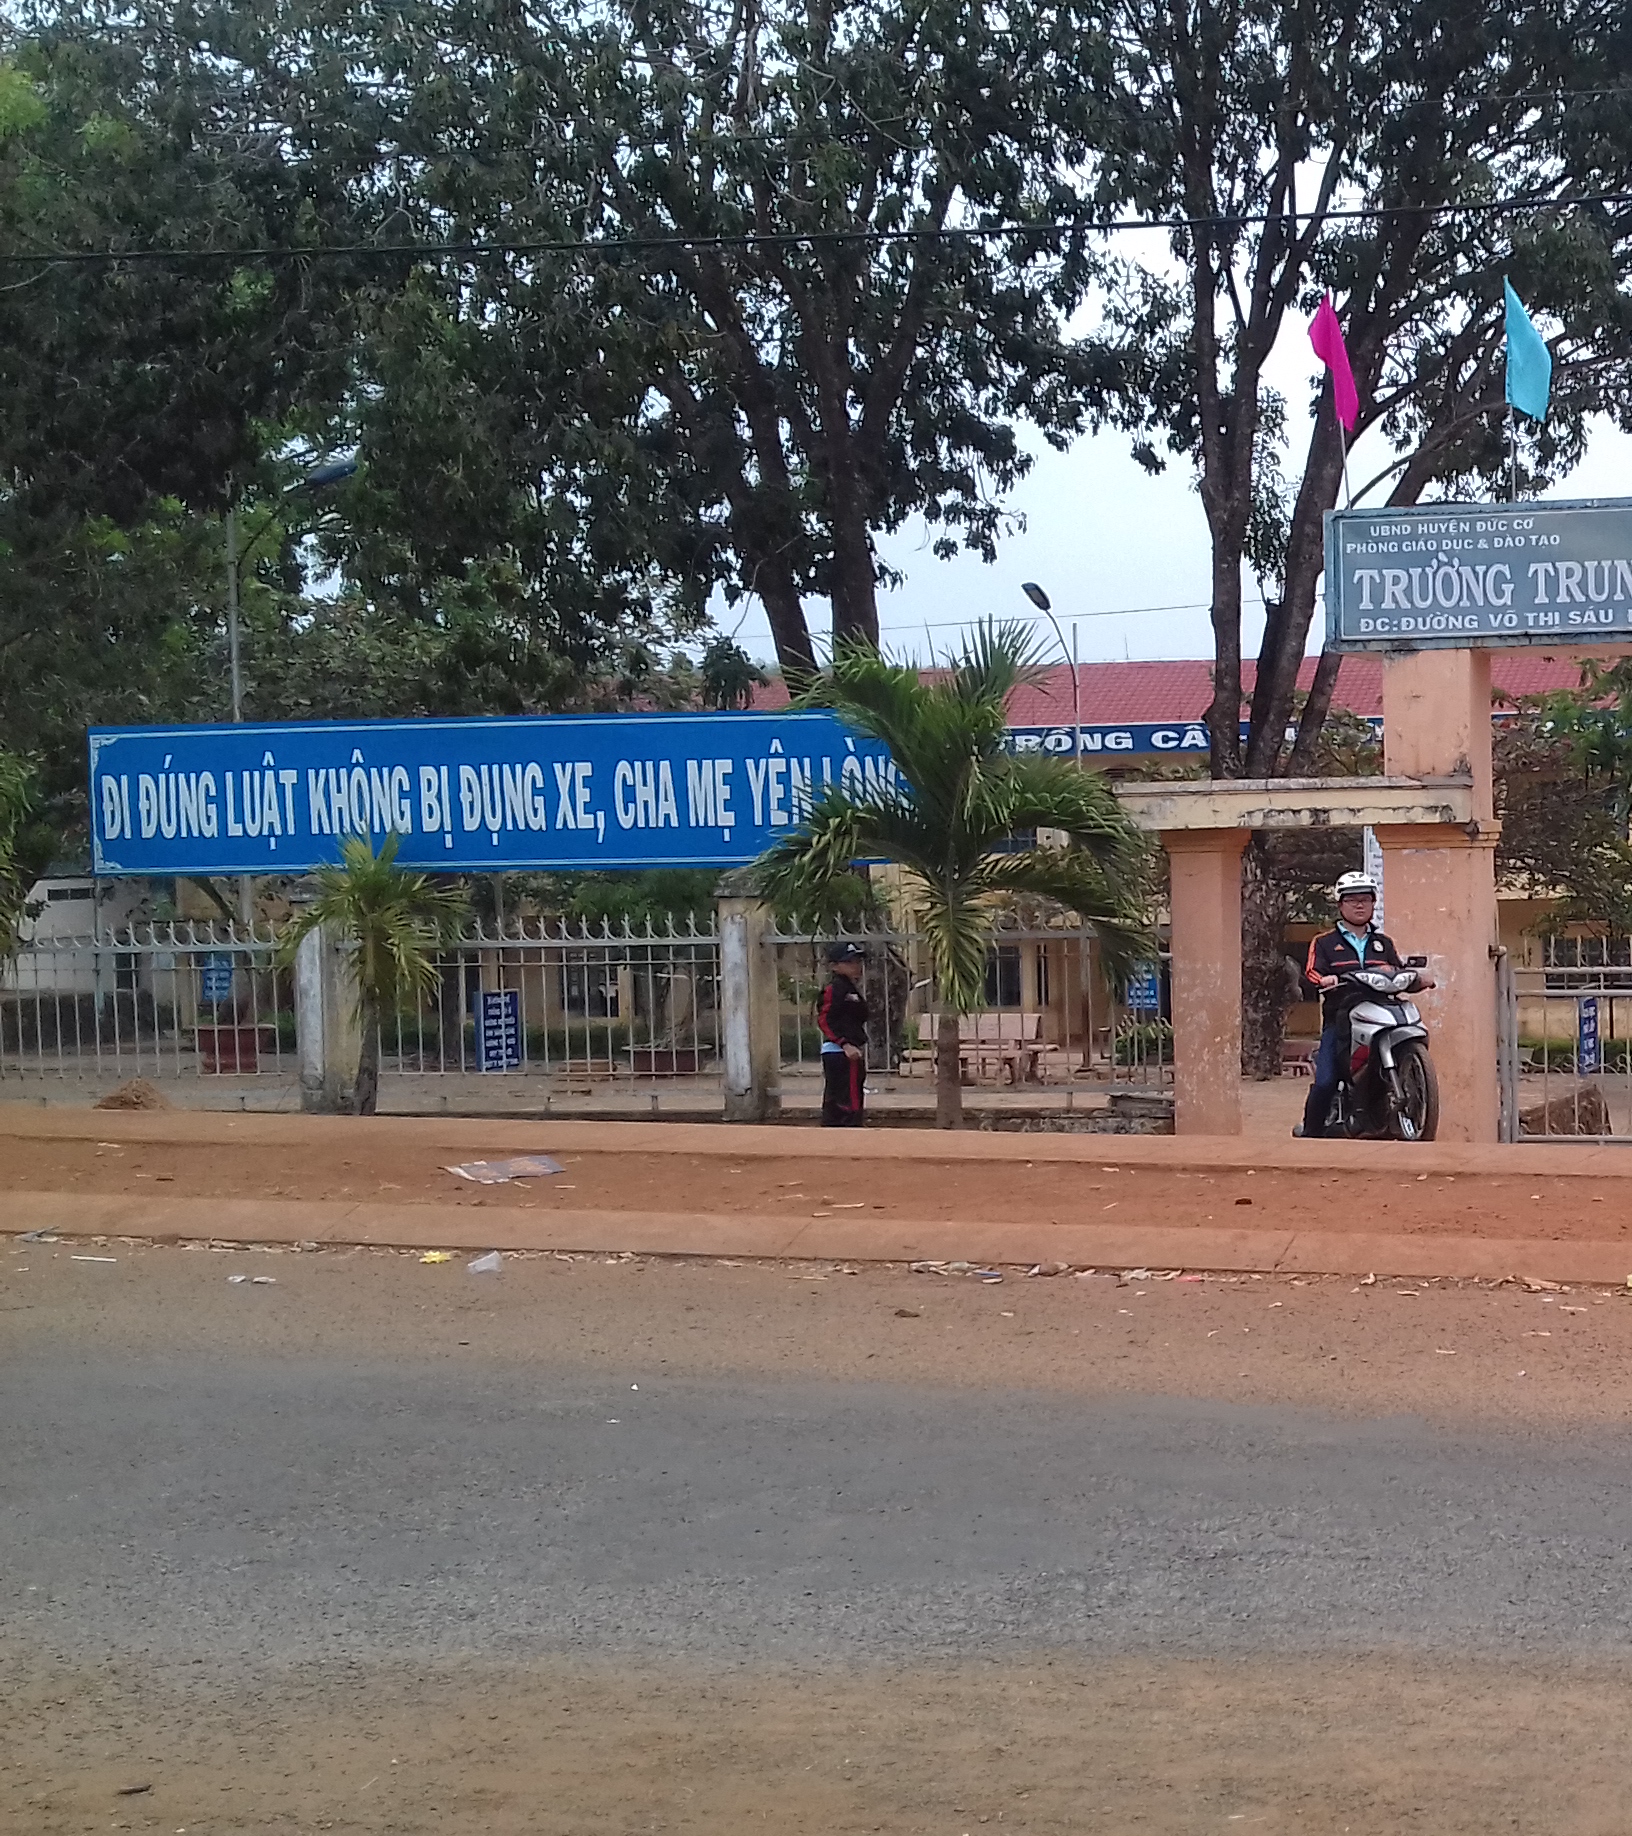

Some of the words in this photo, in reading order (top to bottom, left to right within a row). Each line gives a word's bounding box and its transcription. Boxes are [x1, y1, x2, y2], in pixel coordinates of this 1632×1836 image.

[1370, 524, 1411, 537] UBND
[1418, 519, 1470, 536] HUYỆN
[1476, 518, 1508, 532] ĐỨC
[1513, 518, 1535, 531] CƠ
[1346, 540, 1399, 554] PHÒNG
[1402, 536, 1437, 551] GIÁO
[1442, 538, 1473, 553] DỤC
[1477, 538, 1489, 549] &
[1493, 533, 1526, 548] ĐÀO
[1529, 535, 1561, 548] TẠO
[1353, 552, 1515, 610] TRƯỜNG
[1489, 610, 1518, 628] VÕ
[1524, 611, 1561, 629] THỊ
[1568, 606, 1613, 625] SÁU
[1151, 725, 1212, 749] CÂ
[101, 774, 131, 839] ĐI
[138, 754, 218, 839] ĐÚNG
[225, 751, 298, 850] LUẬT
[308, 748, 412, 834] KHÔNG
[419, 765, 453, 848] BỊ
[459, 762, 546, 846] ĐỤNG
[552, 762, 605, 843] XE,
[614, 759, 679, 829] CHA
[686, 759, 735, 842] MẸ
[745, 738, 814, 826] YÊN
